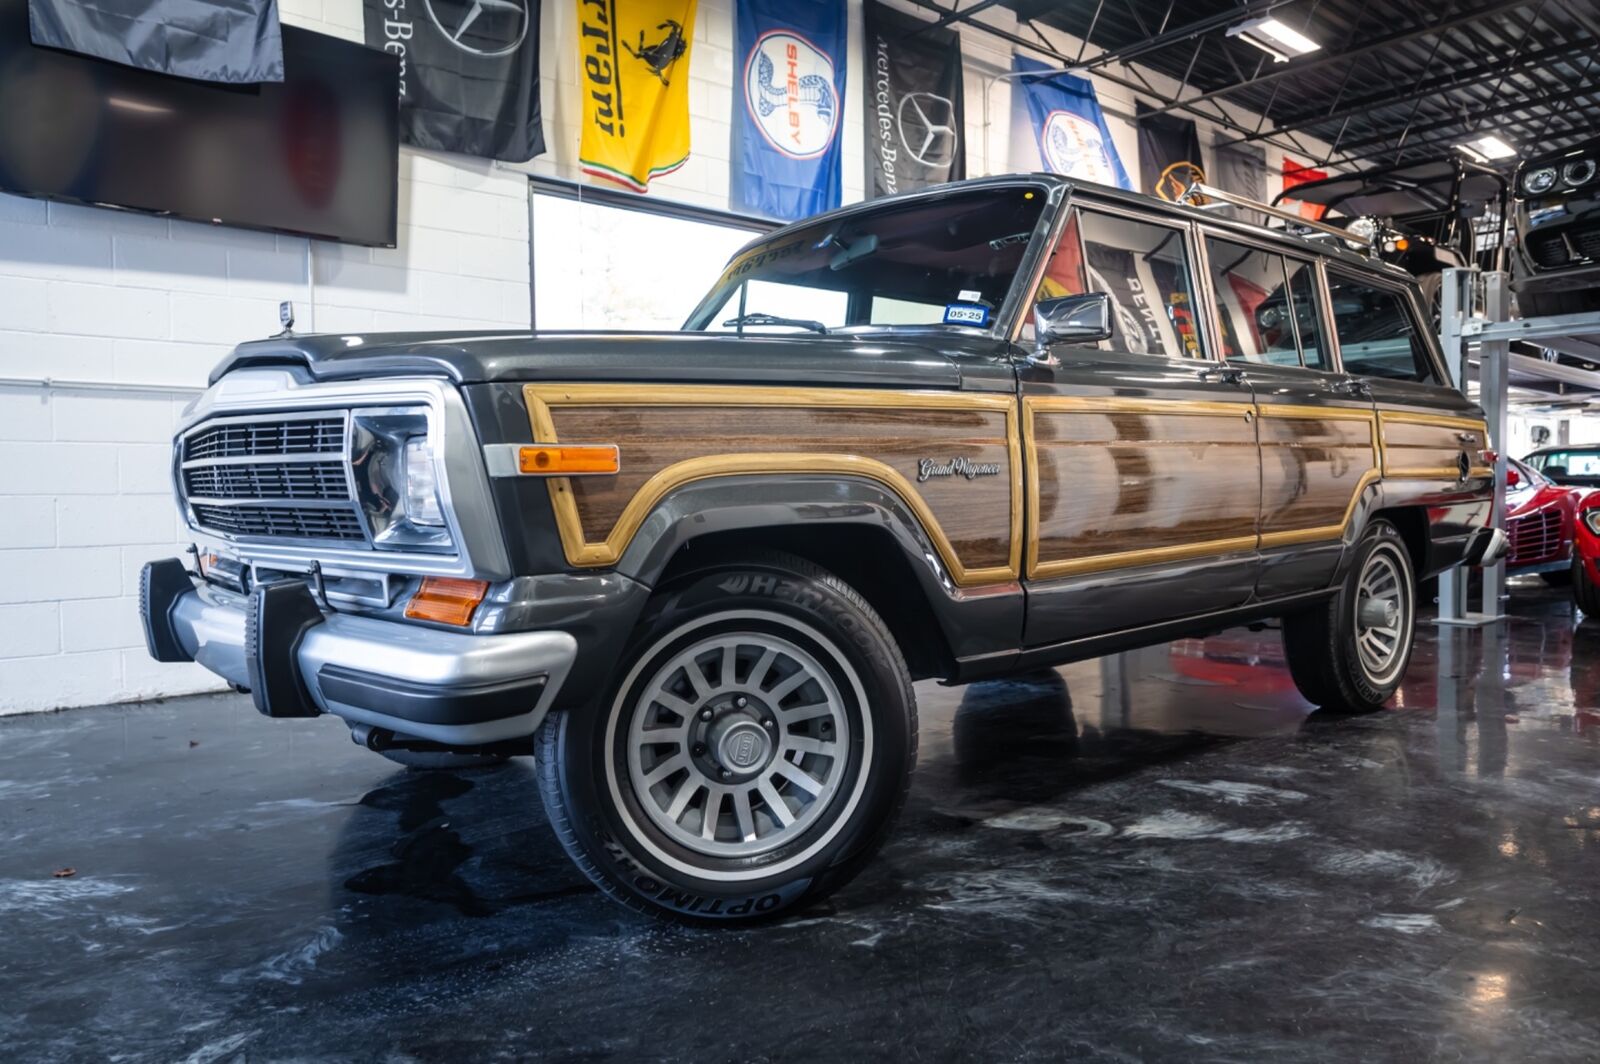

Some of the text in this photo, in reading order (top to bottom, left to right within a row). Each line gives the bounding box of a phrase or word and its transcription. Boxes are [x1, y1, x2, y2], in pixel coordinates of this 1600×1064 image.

[786, 43, 801, 144] SHELBY
[876, 34, 898, 195] Mercedes-Benz
[918, 456, 1001, 481] Grand Wagoneer
[633, 874, 782, 917] OPTIMO
